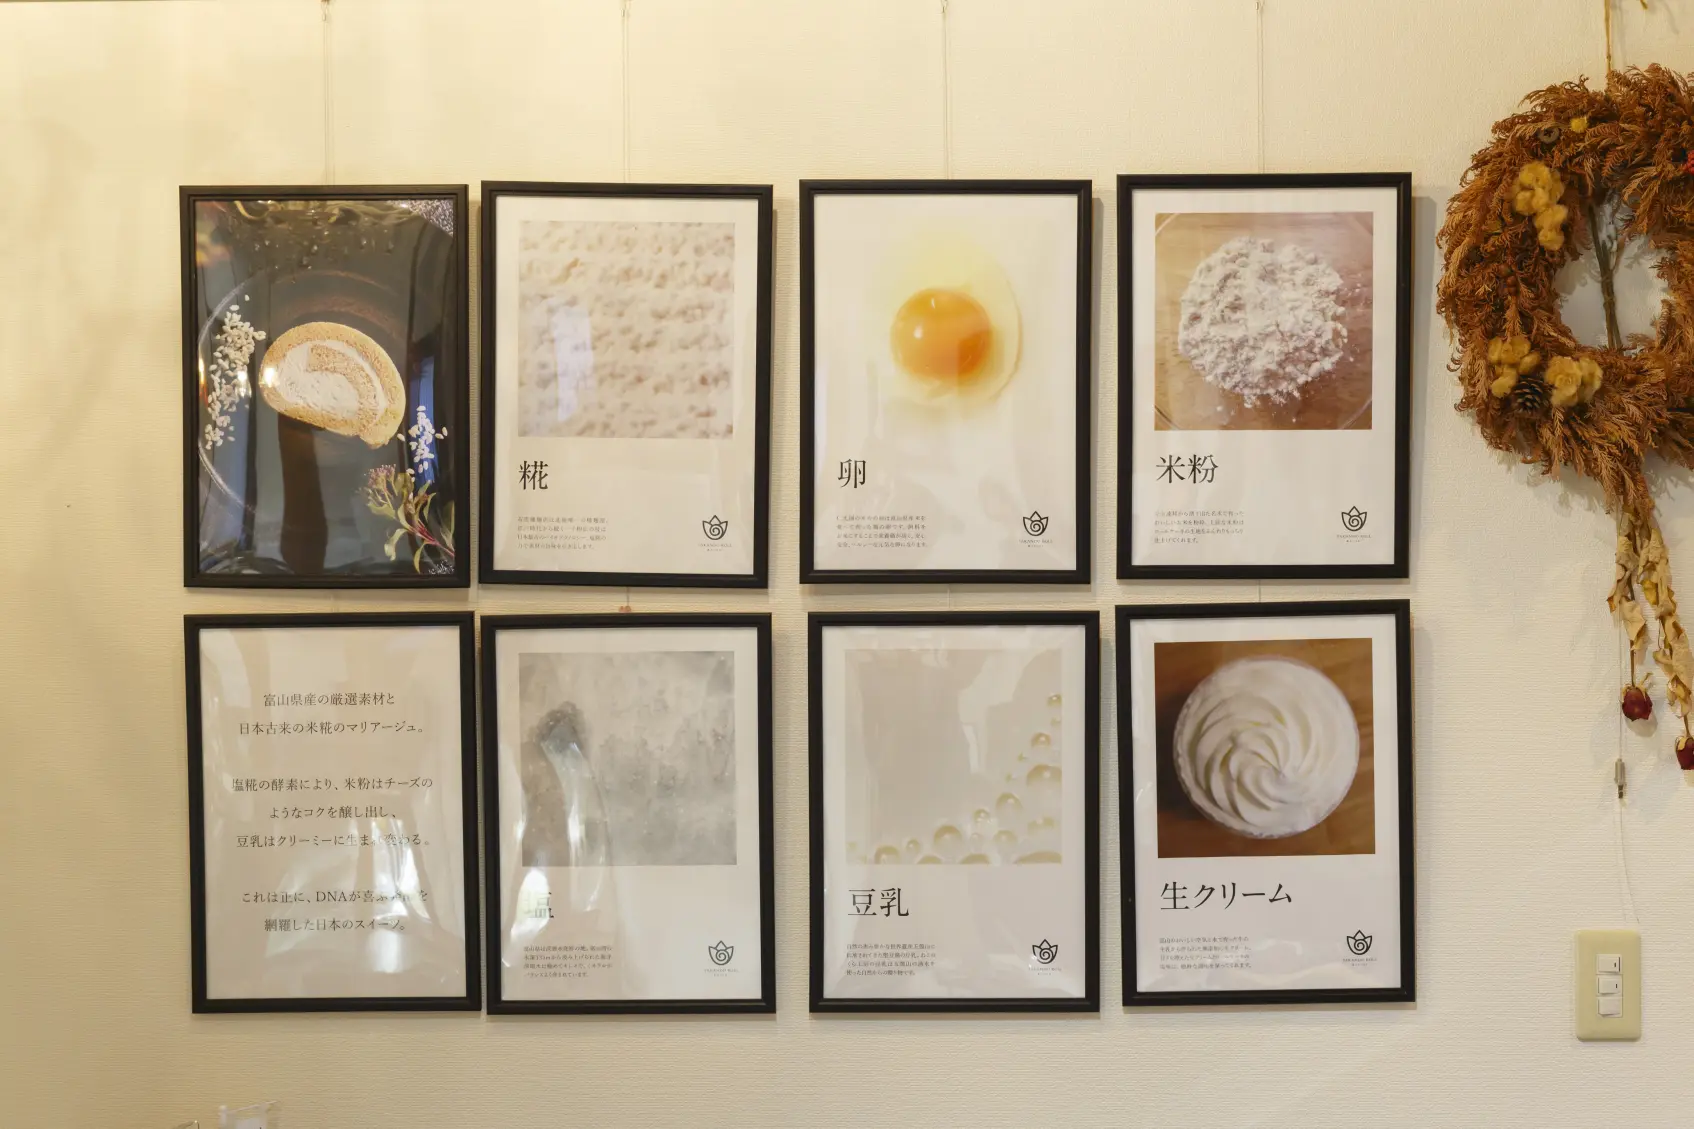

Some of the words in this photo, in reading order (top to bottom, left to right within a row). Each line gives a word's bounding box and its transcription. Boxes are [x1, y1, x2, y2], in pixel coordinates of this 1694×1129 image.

[518, 460, 549, 491] 糀
[837, 458, 867, 489] 卵
[1155, 454, 1219, 484] 米粉
[263, 691, 396, 708] 富山県産の厳選素材と
[239, 720, 425, 736] 日本古来の米糀のマリアージュ。
[269, 805, 398, 820] ようなコクを醸し出し、
[847, 887, 909, 918] 豆乳
[1160, 881, 1293, 910] 生クリーム
[264, 917, 407, 933] 網羅した日本のスイーツ。
